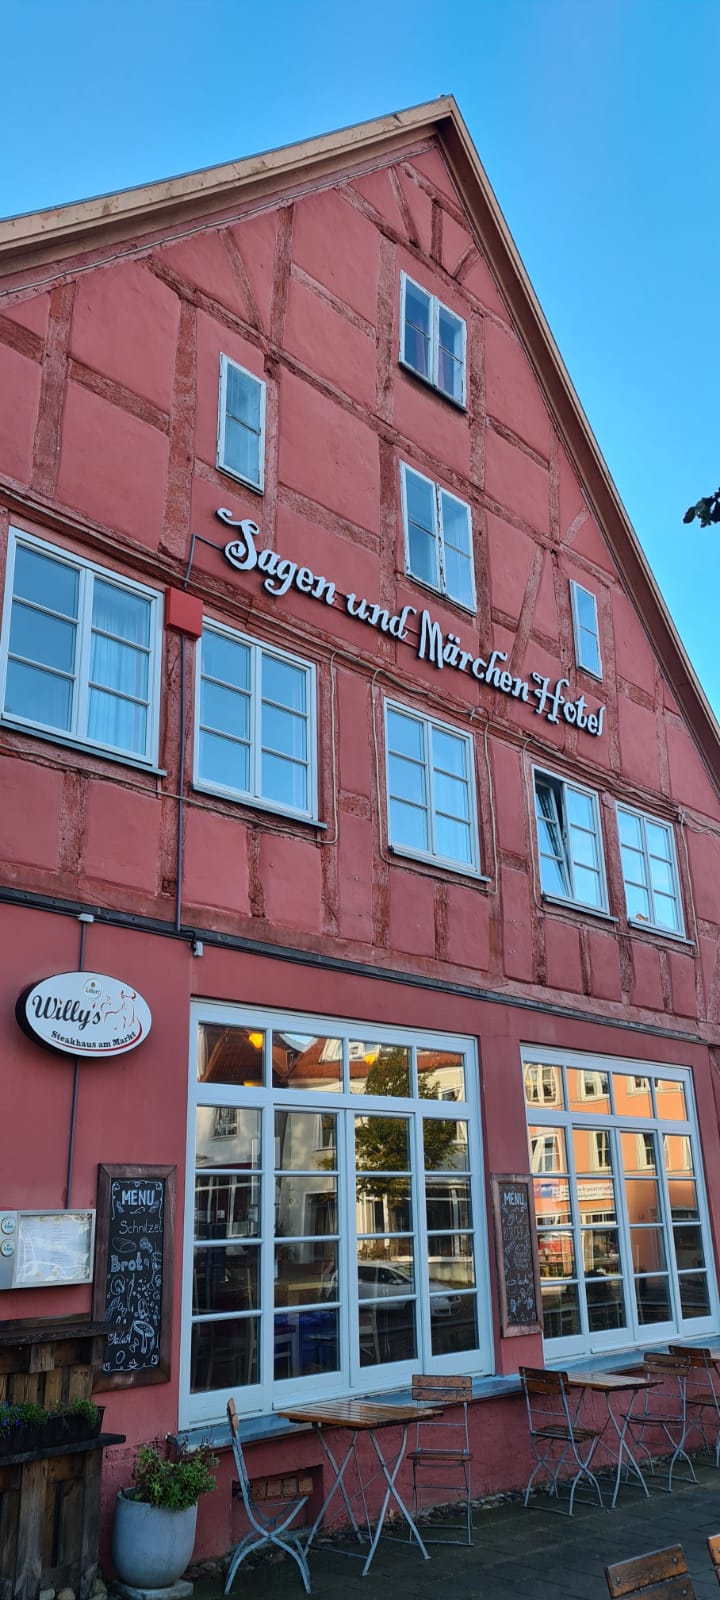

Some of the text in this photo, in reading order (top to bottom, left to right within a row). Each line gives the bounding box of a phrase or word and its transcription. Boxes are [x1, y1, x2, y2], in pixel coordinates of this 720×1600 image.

[217, 507, 606, 737] Sagen und Märchen Hotel
[32, 995, 101, 1030] Willy's
[51, 1030, 96, 1048] Steakhaus
[112, 1032, 136, 1046] Markt
[122, 1189, 154, 1206] MENU
[503, 1192, 523, 1206] MENU
[119, 1219, 163, 1235] Schnitzel
[111, 1252, 143, 1272] Brot
